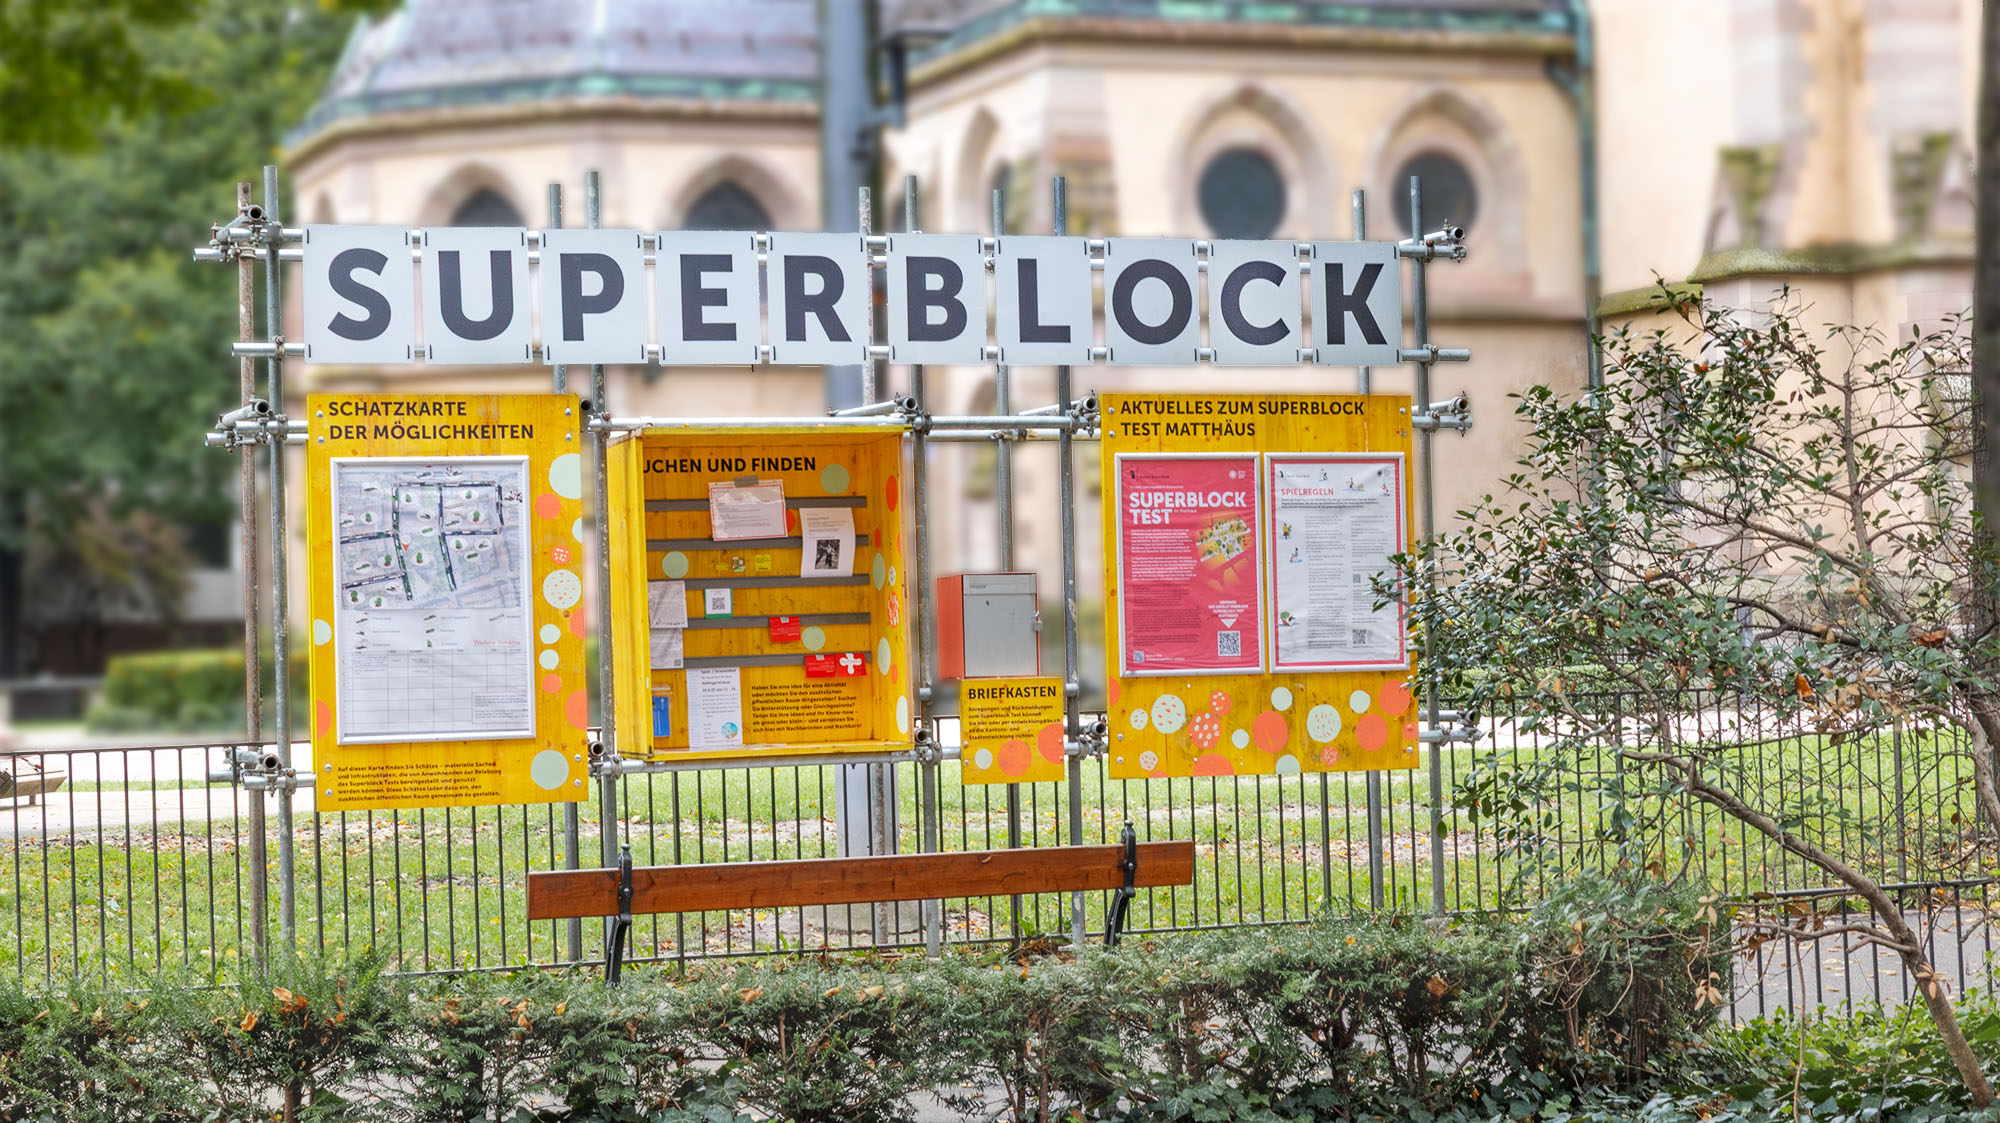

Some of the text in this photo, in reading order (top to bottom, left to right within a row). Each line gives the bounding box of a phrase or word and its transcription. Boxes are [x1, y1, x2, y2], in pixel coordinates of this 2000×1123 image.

[327, 246, 1388, 344] SUPERBLOCK
[329, 402, 466, 416] SCHATZKARTE
[1121, 401, 1364, 415] AKTUELLES ZUM SUPERBLOCK
[330, 421, 534, 439] DER MÖGLICHKEITEN
[1121, 419, 1255, 436] TEST MATTHÄUS
[708, 458, 746, 472] UND
[752, 457, 816, 472] FINDEN
[1129, 492, 1246, 508] SUPERBLOCK
[1129, 508, 1172, 524] TEST
[968, 686, 1056, 699] BRIEFKASTEN
